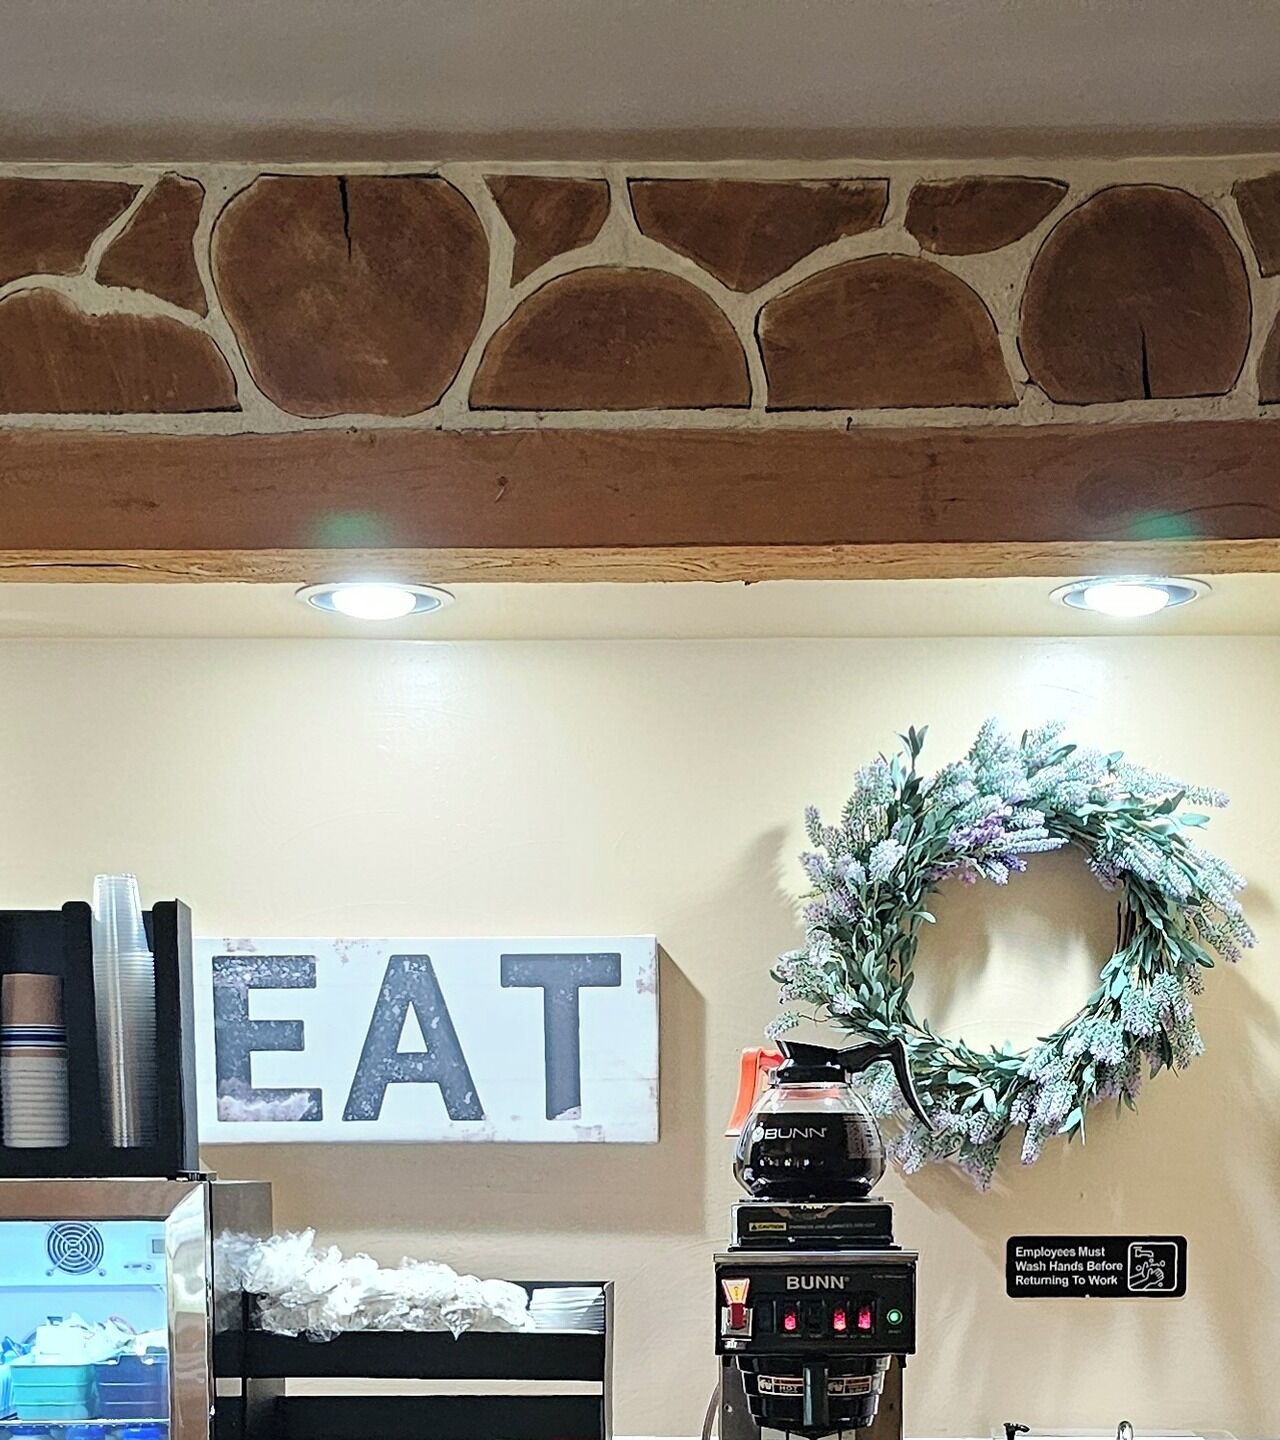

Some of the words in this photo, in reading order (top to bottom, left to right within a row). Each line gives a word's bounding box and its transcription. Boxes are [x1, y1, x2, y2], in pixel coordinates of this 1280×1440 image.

[213, 953, 621, 1121] EAT
[765, 1128, 825, 1139] BUNN
[1015, 1247, 1076, 1259] Employees
[1078, 1247, 1105, 1257] Must
[1015, 1261, 1046, 1271] Wash
[1049, 1261, 1084, 1271] Hands
[1086, 1261, 1123, 1271] Before
[786, 1275, 845, 1290] BUNN
[1015, 1275, 1069, 1287] Returning
[1072, 1275, 1086, 1285] To
[1088, 1275, 1118, 1285] Work
